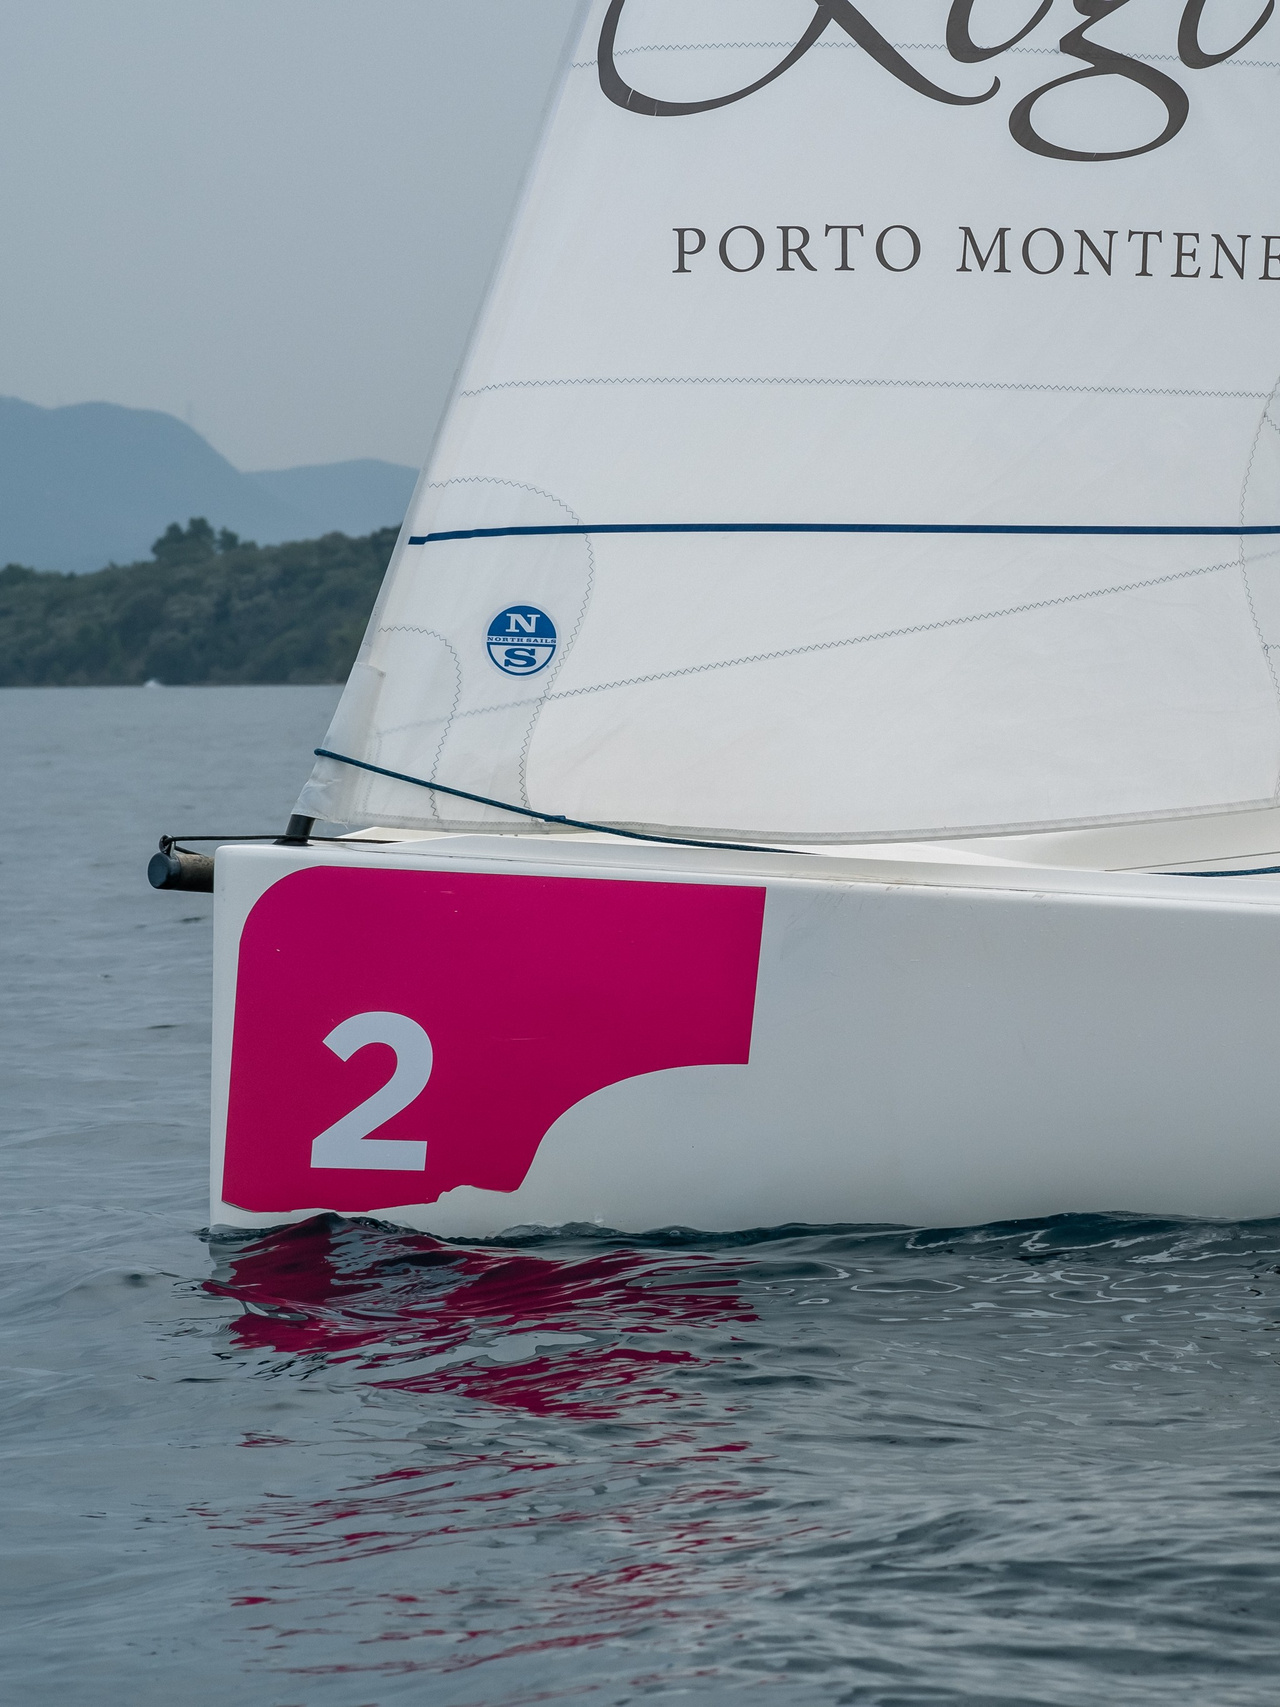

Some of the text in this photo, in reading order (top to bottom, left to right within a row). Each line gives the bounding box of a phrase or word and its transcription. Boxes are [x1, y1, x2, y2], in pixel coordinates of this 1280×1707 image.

[672, 223, 921, 274] PORTO
[506, 613, 540, 632] N
[504, 648, 536, 667] S
[310, 1011, 434, 1172] 2
